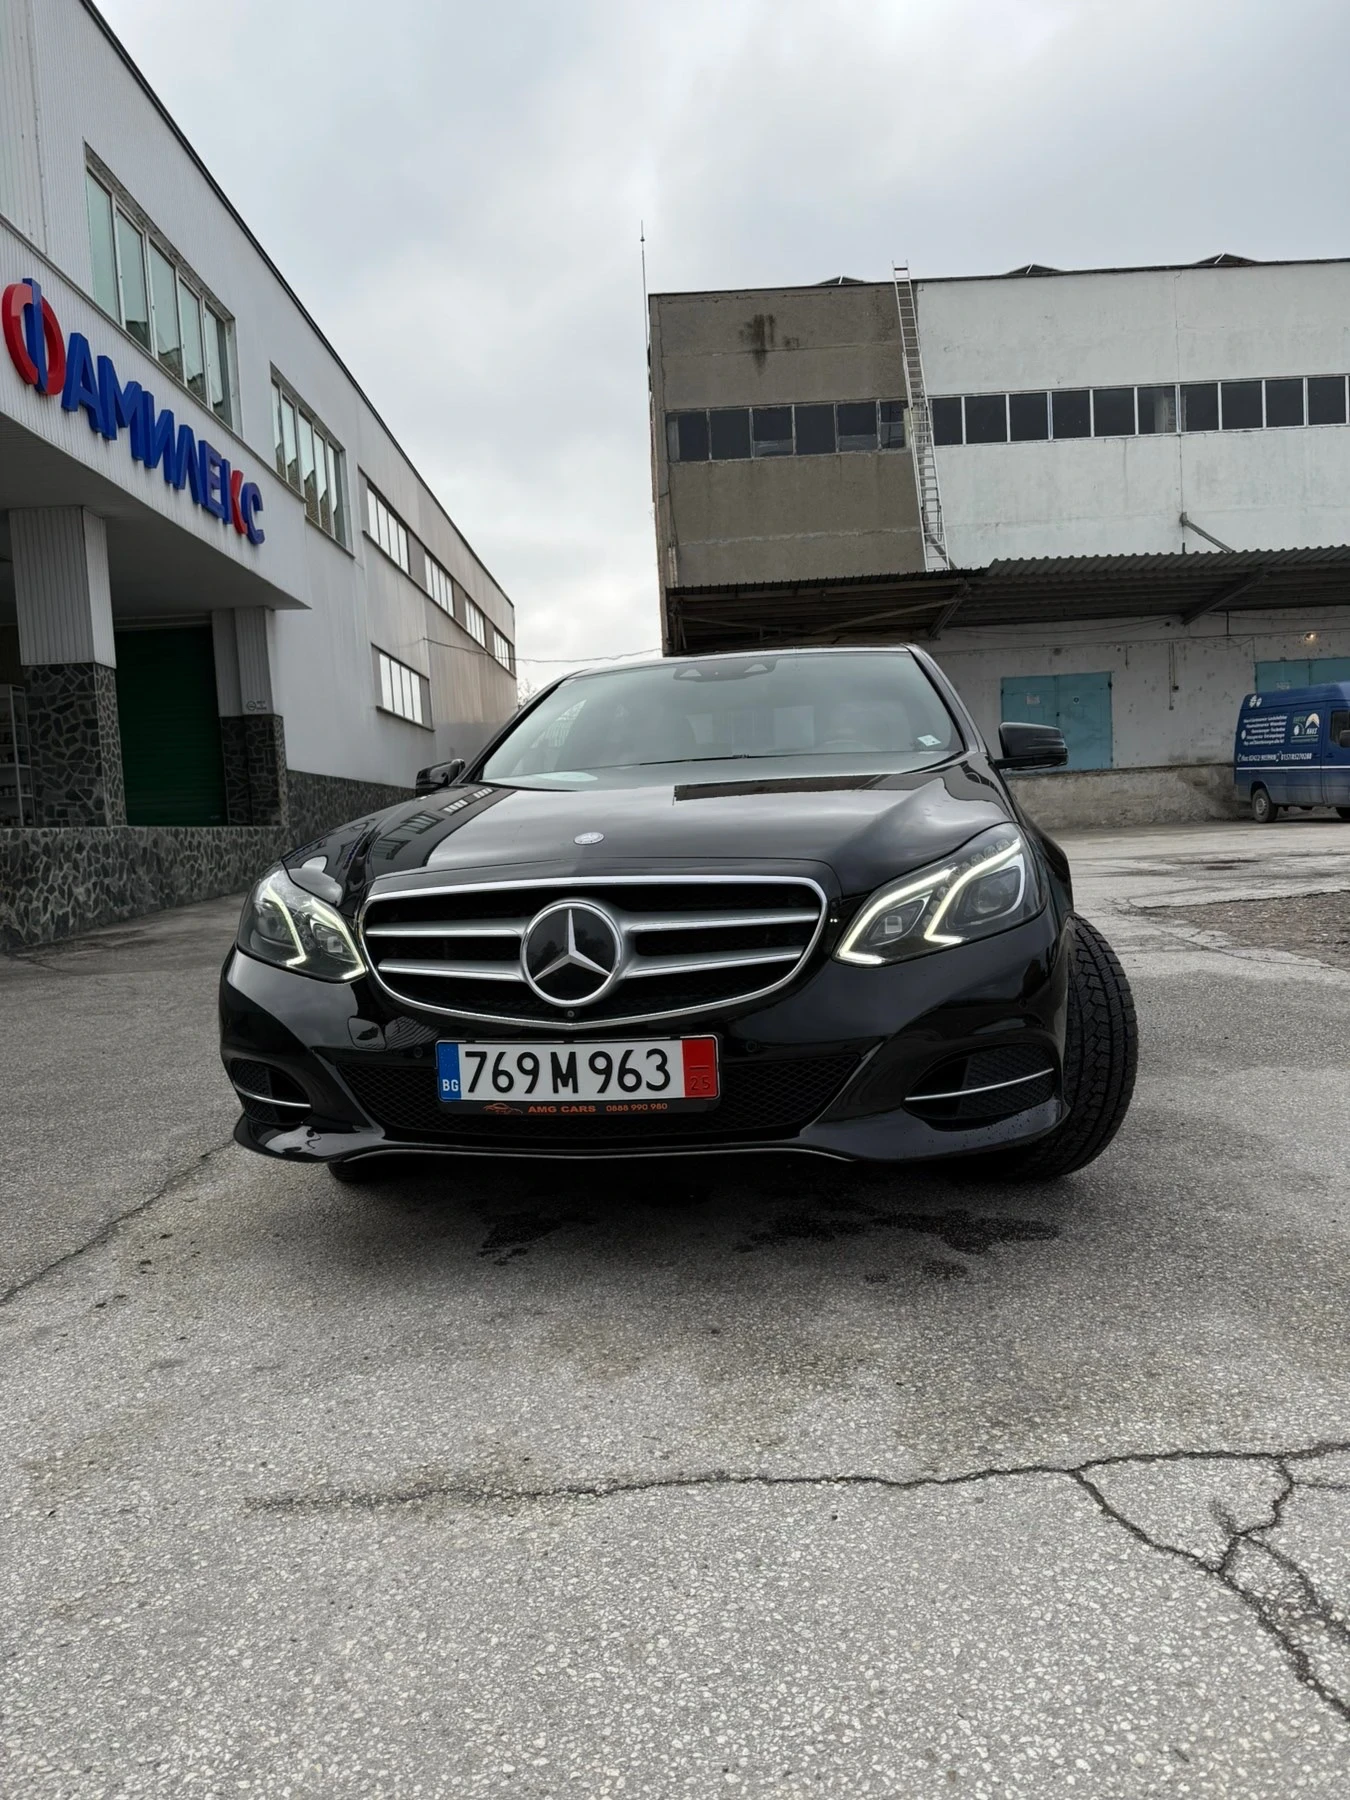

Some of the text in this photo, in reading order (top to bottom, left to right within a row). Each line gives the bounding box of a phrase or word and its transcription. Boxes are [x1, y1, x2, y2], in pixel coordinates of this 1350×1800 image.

[2, 278, 265, 545] ФАМИЛЕКС
[465, 1048, 671, 1094] 769 M 963
[442, 1079, 459, 1092] BG
[690, 1076, 710, 1090] 25
[528, 1105, 558, 1113] AMG
[560, 1105, 597, 1113] CARS
